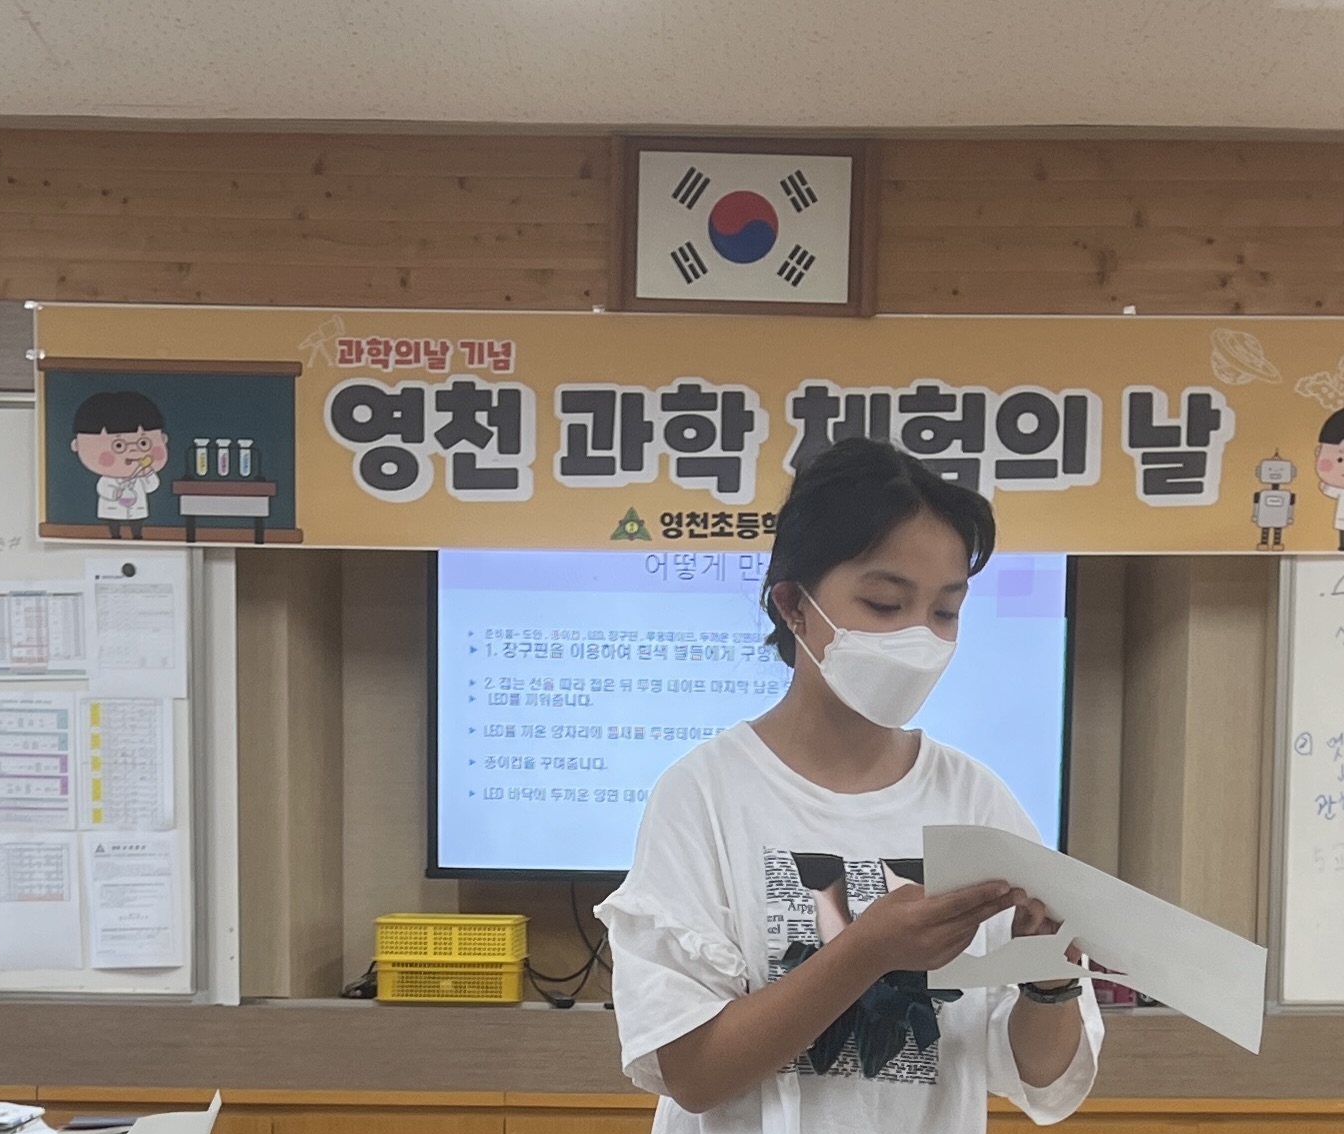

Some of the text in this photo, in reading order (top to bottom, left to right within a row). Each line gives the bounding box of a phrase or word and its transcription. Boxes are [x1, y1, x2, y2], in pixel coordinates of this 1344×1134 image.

[337, 337, 514, 372] 과학의날 기념
[329, 380, 1223, 497] 영천 과학 체험의 날
[645, 553, 726, 581] 어떻게
[570, 642, 632, 660] 이용하여
